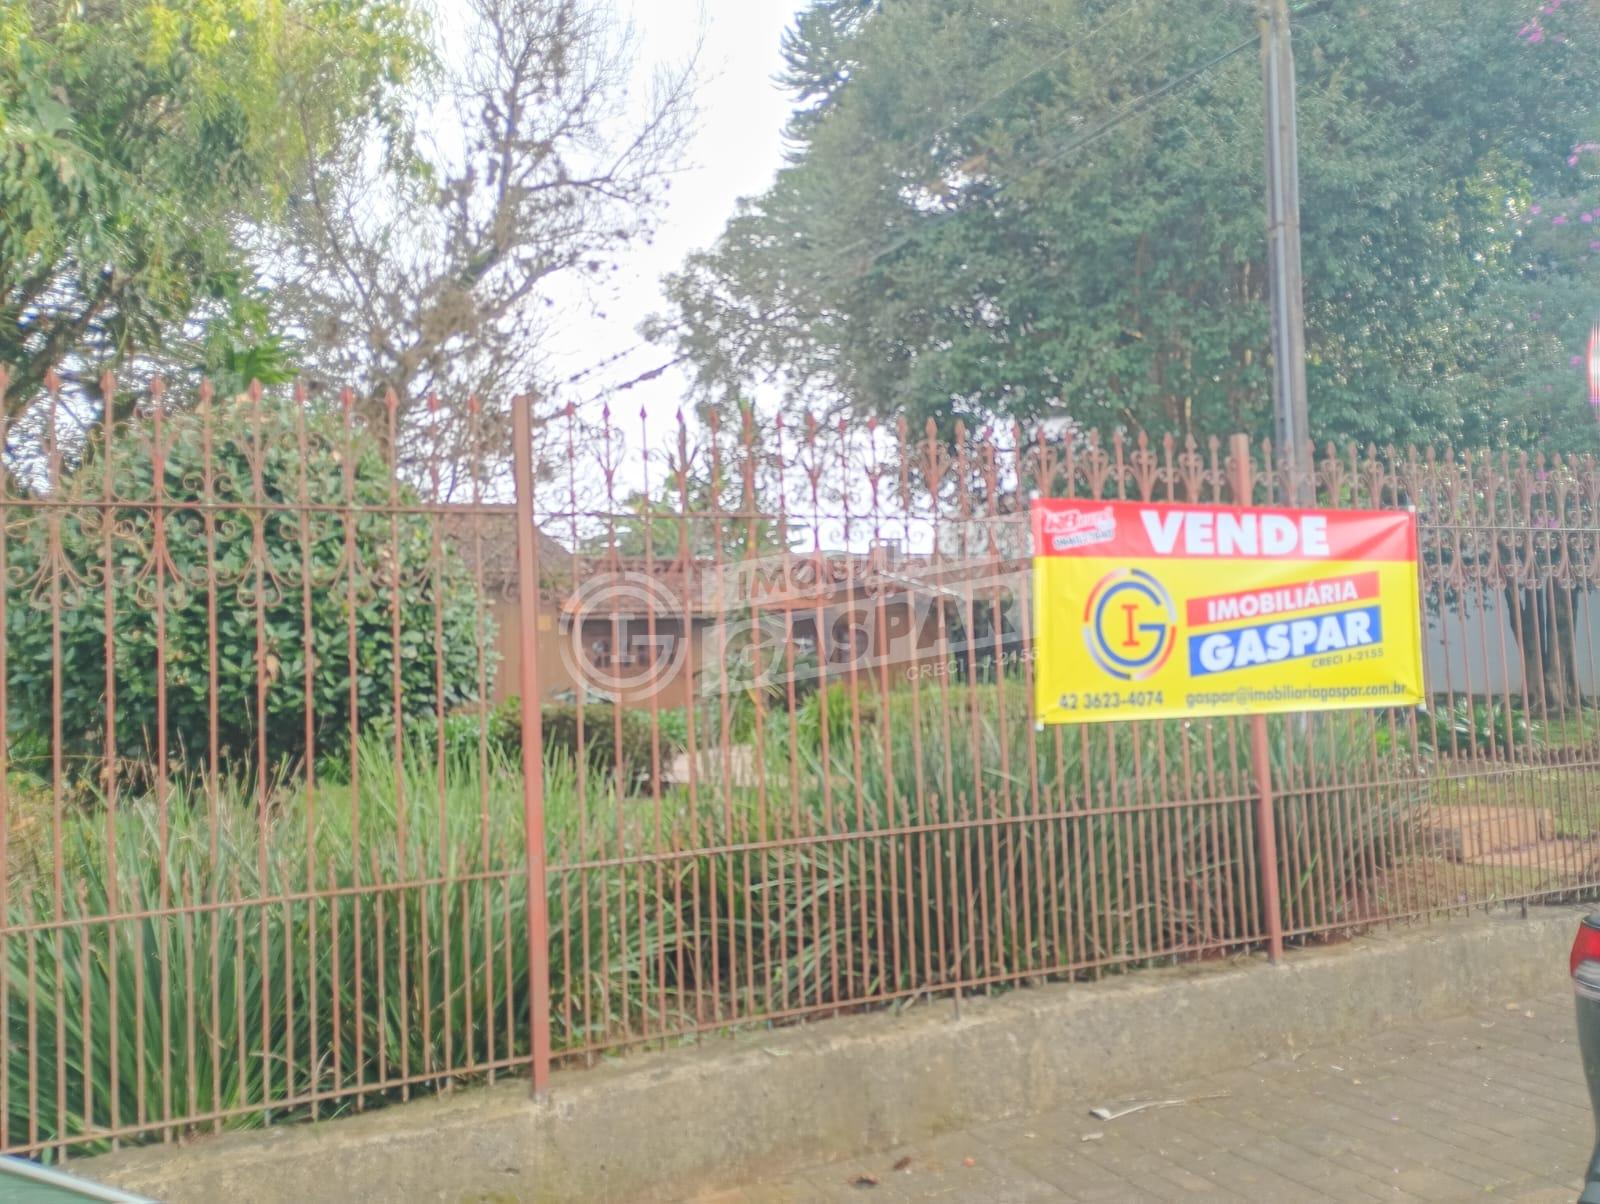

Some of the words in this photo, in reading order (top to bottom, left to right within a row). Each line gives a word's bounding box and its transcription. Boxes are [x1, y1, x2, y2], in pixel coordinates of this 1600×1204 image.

[1139, 509, 1330, 557] VENDE
[1207, 579, 1359, 623] IMOBILIÁRIA
[1198, 610, 1374, 673] GASPAR
[1311, 654, 1344, 669] CRECI
[1059, 691, 1078, 710] 42
[1083, 688, 1165, 710] 3623-4074
[1185, 679, 1408, 709] gaspar@imobiliariagaspar.com.br
